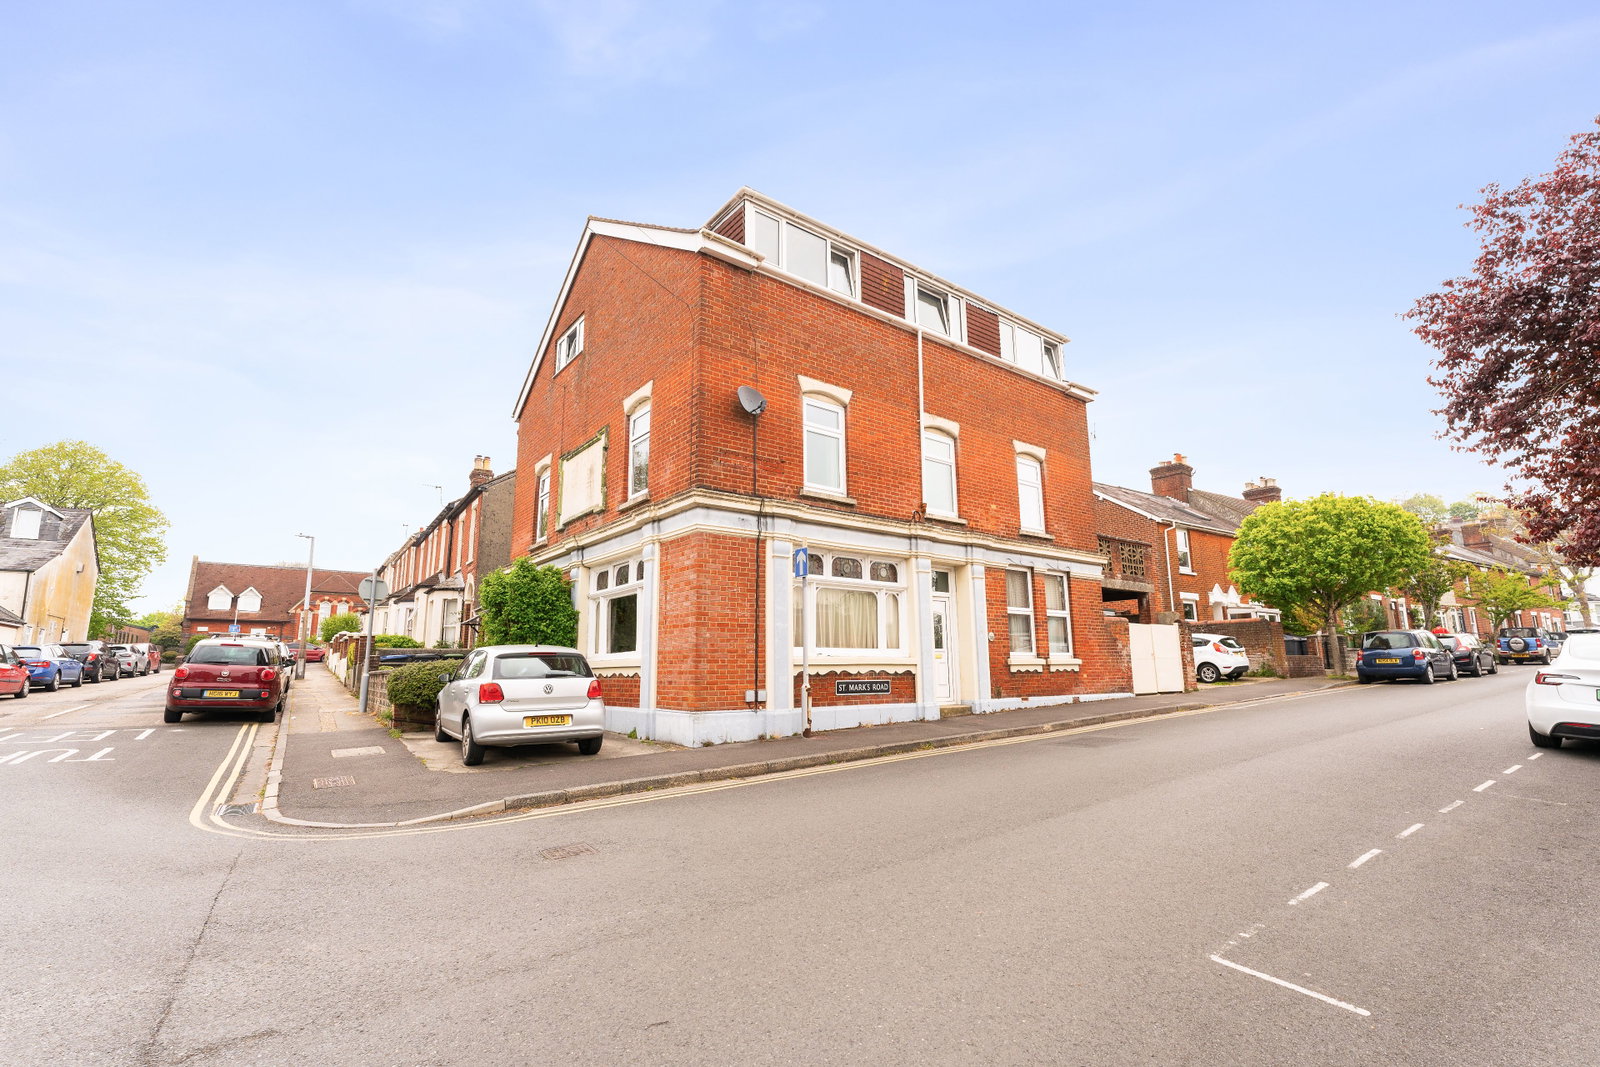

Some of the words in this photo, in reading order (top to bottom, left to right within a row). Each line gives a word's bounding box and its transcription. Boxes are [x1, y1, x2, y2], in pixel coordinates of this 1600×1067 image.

[872, 683, 889, 691] ROAD
[531, 716, 549, 724] PK10
[550, 715, 566, 724] OZB
